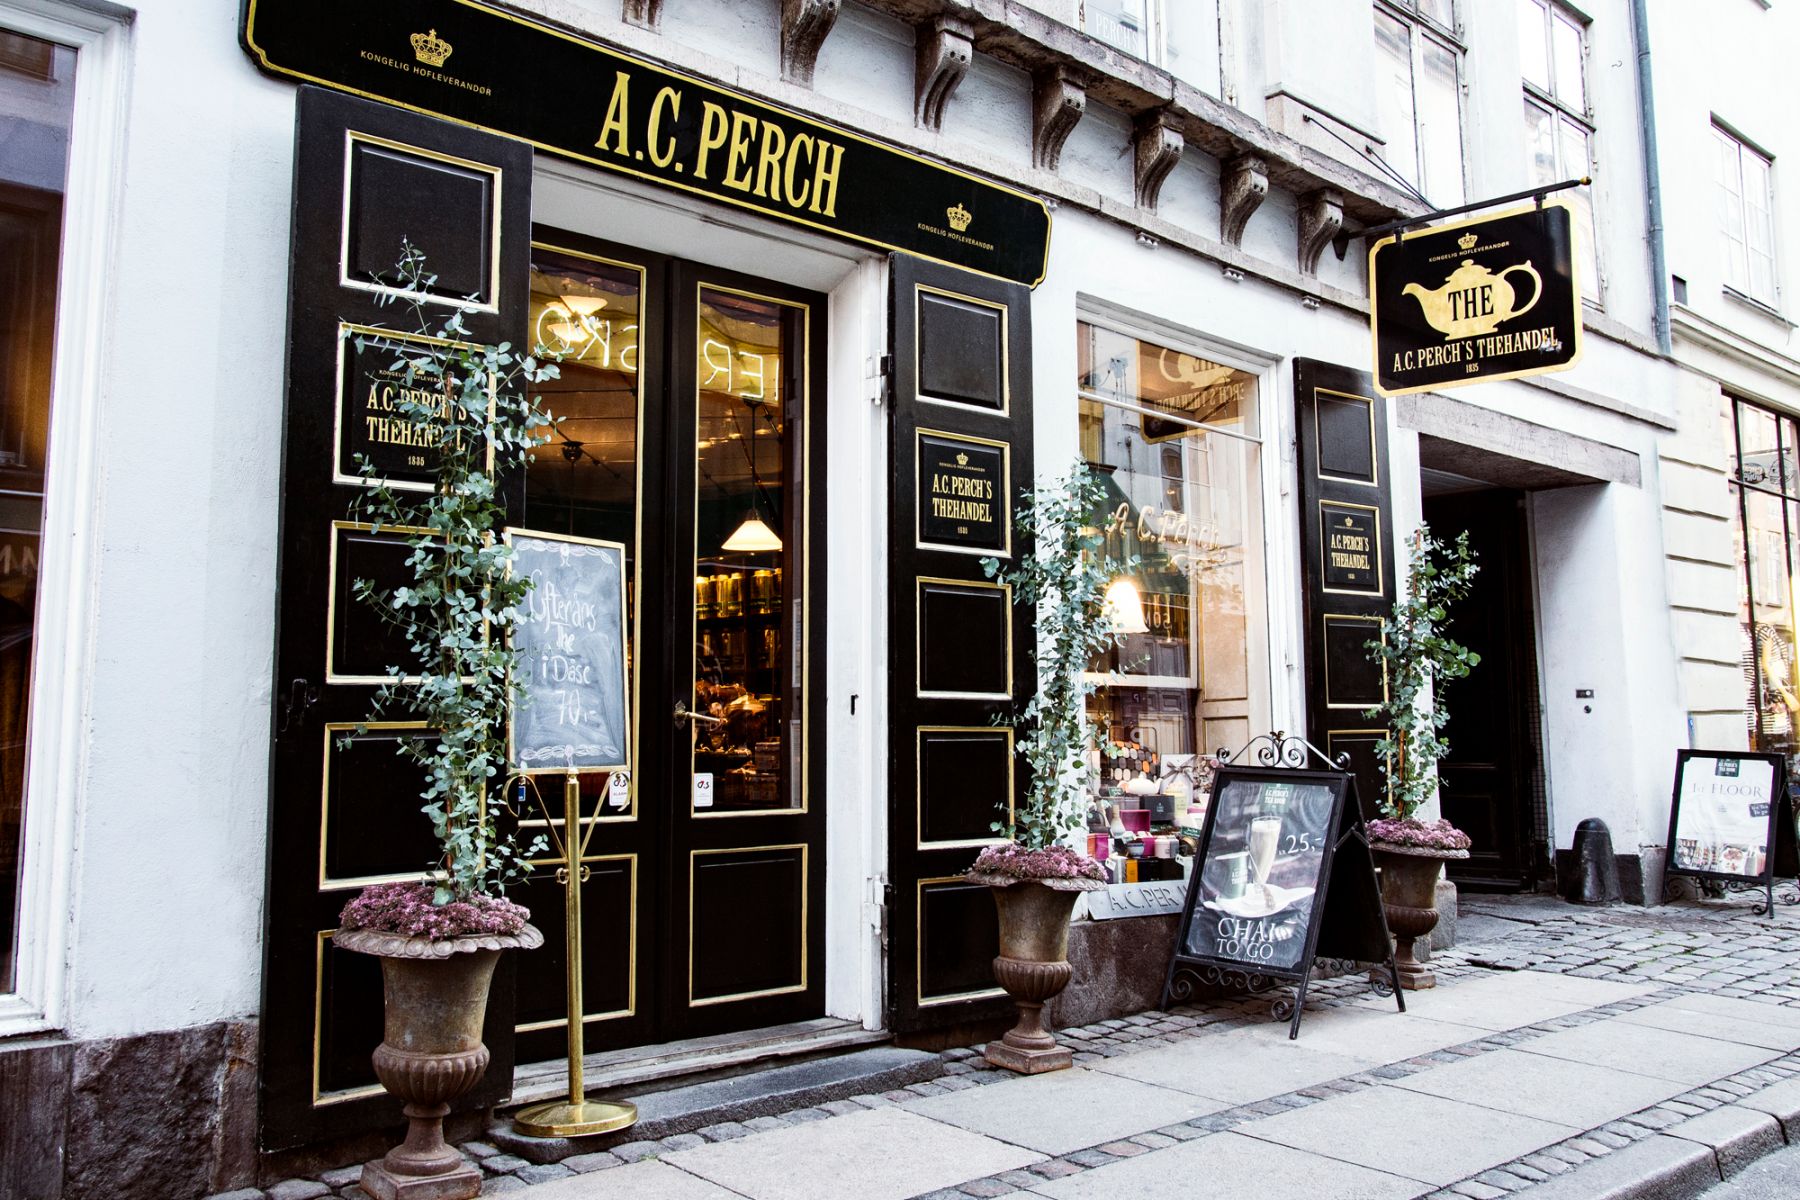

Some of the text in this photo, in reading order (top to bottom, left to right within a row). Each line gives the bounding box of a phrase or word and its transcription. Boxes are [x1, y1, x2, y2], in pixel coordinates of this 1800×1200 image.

[360, 50, 492, 97] KONGELIG HOFLEVERANDØR
[594, 70, 845, 218] A.C. PERCH
[917, 223, 994, 251] KONGELIG HOFLEVERANDØR
[1428, 241, 1510, 263] KONGELIG HOFLEVERANDØR
[1448, 284, 1494, 322] THE
[1393, 352, 1416, 373] A.C.
[1477, 326, 1559, 358] THEHANDEL
[1465, 363, 1479, 374] 1835
[366, 385, 397, 413] A.C.
[366, 416, 466, 452] THEHANDL
[932, 474, 992, 499] A.C. PERCH'S
[932, 498, 992, 523] THEHANDEL
[1331, 551, 1370, 570] THEHANDEL
[1711, 783, 1762, 798] FLOOR
[1218, 917, 1276, 943] CHAI
[1217, 938, 1240, 955] TO
[1246, 942, 1274, 960] GO
